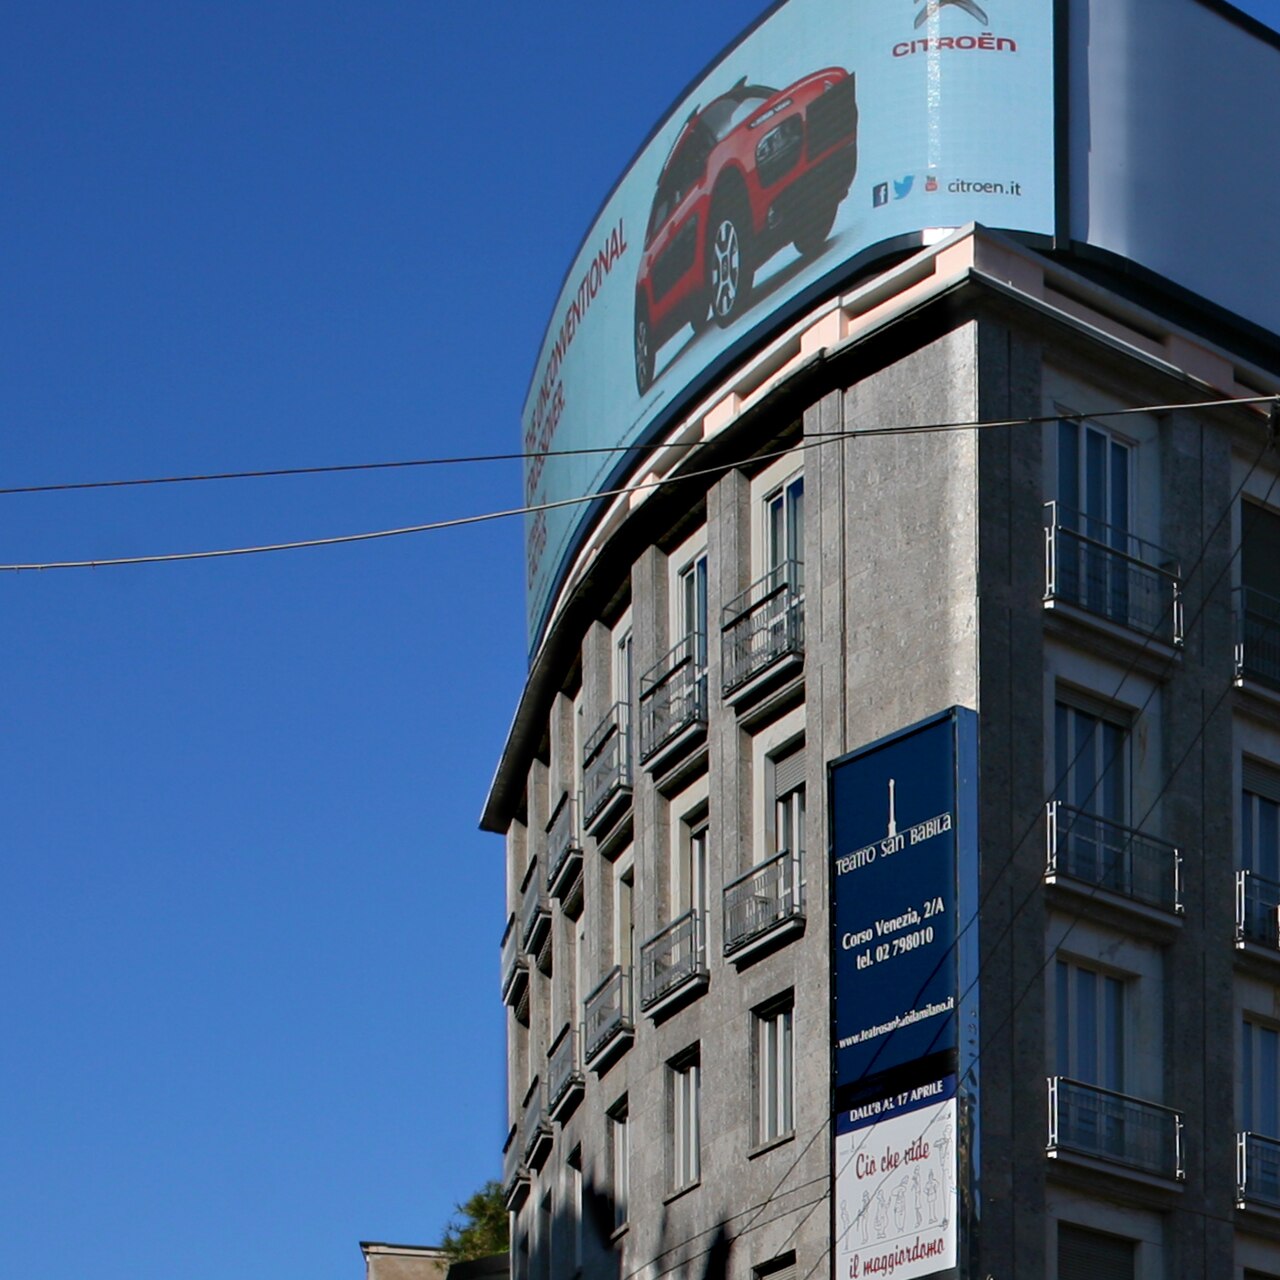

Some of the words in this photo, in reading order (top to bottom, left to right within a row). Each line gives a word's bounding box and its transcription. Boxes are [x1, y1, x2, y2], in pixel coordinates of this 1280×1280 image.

[948, 179, 1021, 196] citroen.it
[842, 924, 873, 951] Corso
[876, 906, 922, 938] Venezia,
[924, 897, 944, 920] 2/A
[856, 949, 874, 970] tel.
[876, 942, 890, 962] 02
[892, 926, 934, 956] 798010
[897, 1092, 908, 1108] 17
[910, 1080, 943, 1102] APRILE
[856, 1153, 877, 1180] Ciò
[881, 1146, 900, 1172] che
[849, 1253, 859, 1280] il
[863, 1236, 944, 1278] maggiordomo
